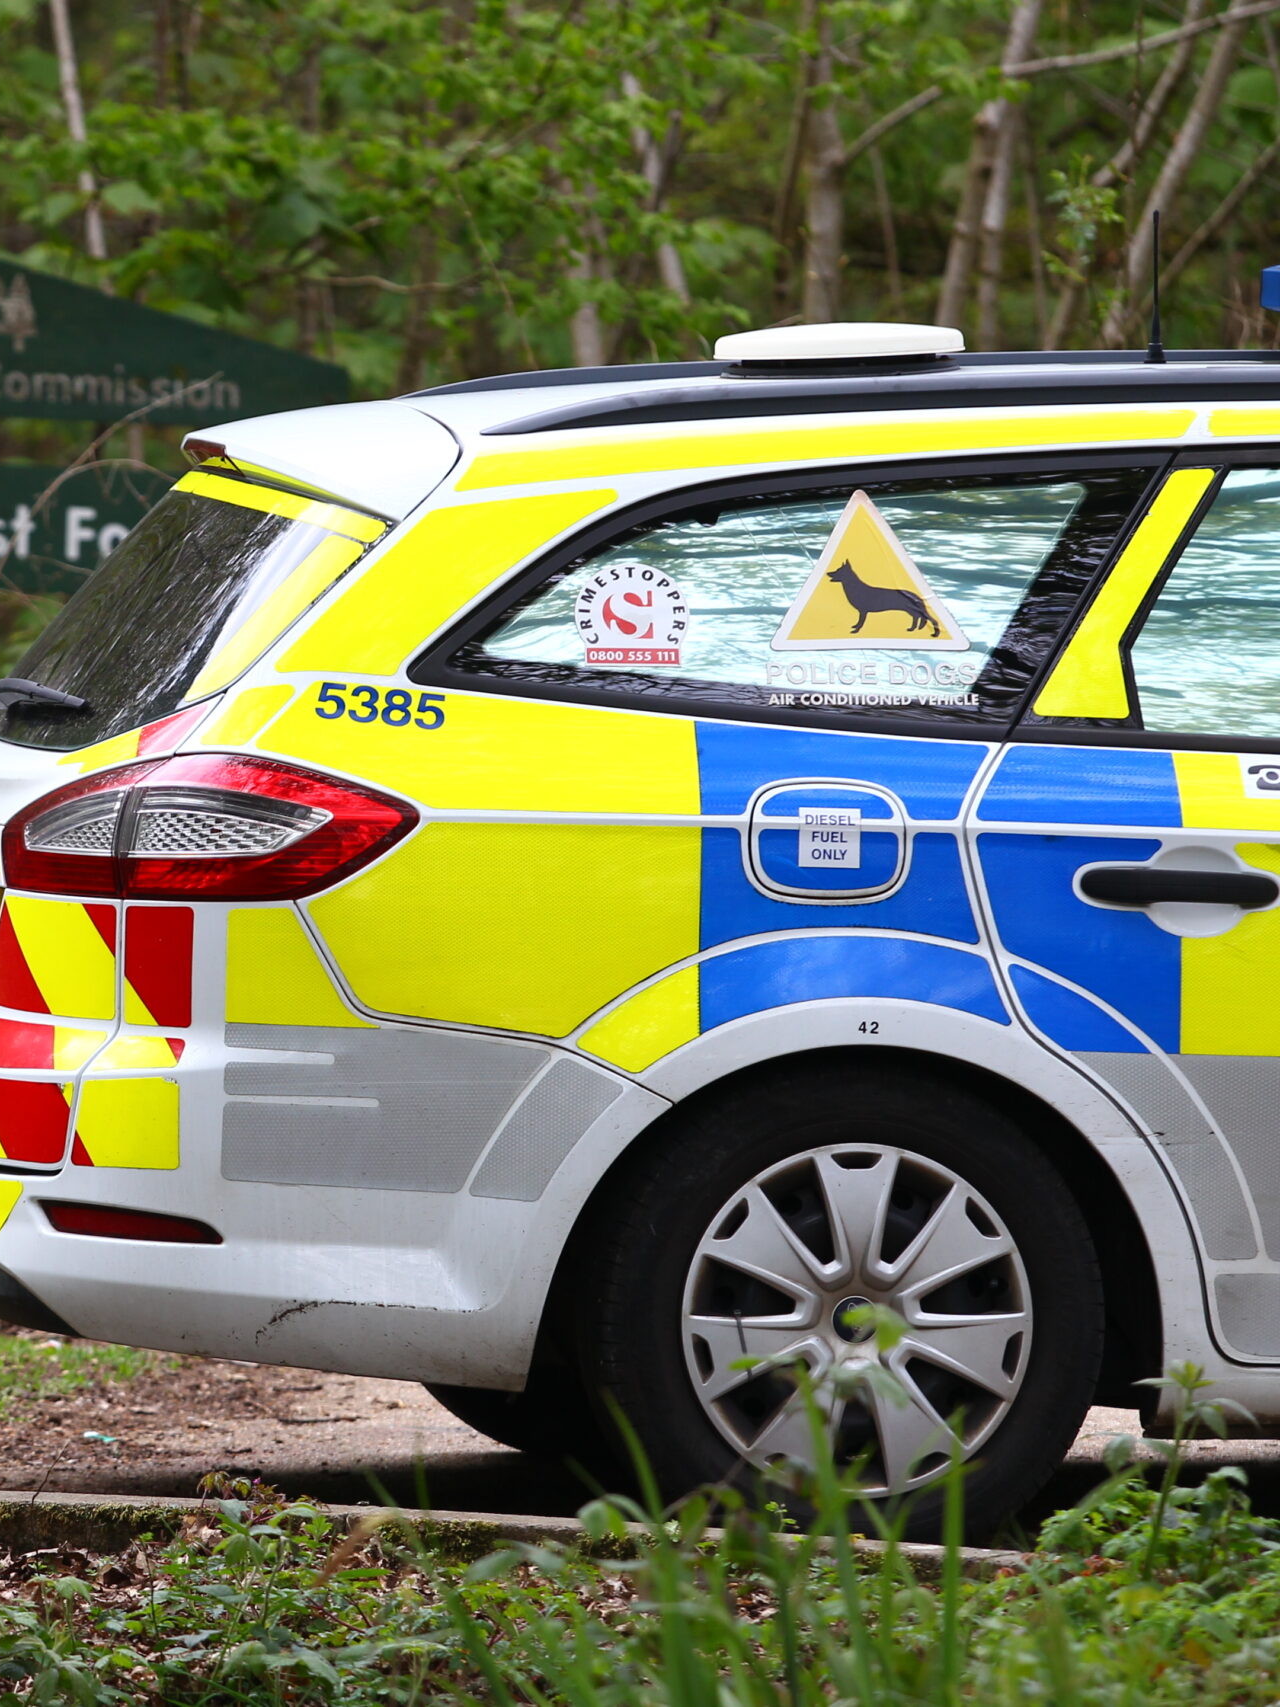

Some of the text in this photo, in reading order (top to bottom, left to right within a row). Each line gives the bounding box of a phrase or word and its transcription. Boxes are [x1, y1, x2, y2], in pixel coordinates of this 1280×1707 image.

[578, 567, 686, 645] CRIMESTOPPERS
[589, 650, 676, 662] 0800 555 111
[765, 662, 978, 686] POLICE DOGS
[315, 682, 446, 730] 5385
[768, 694, 980, 706] AIR CONDITIONED VEHICLE
[805, 814, 856, 826] DIESEL
[811, 831, 848, 843] FUEL
[811, 848, 847, 861] ONLY
[858, 1021, 880, 1034] 42
